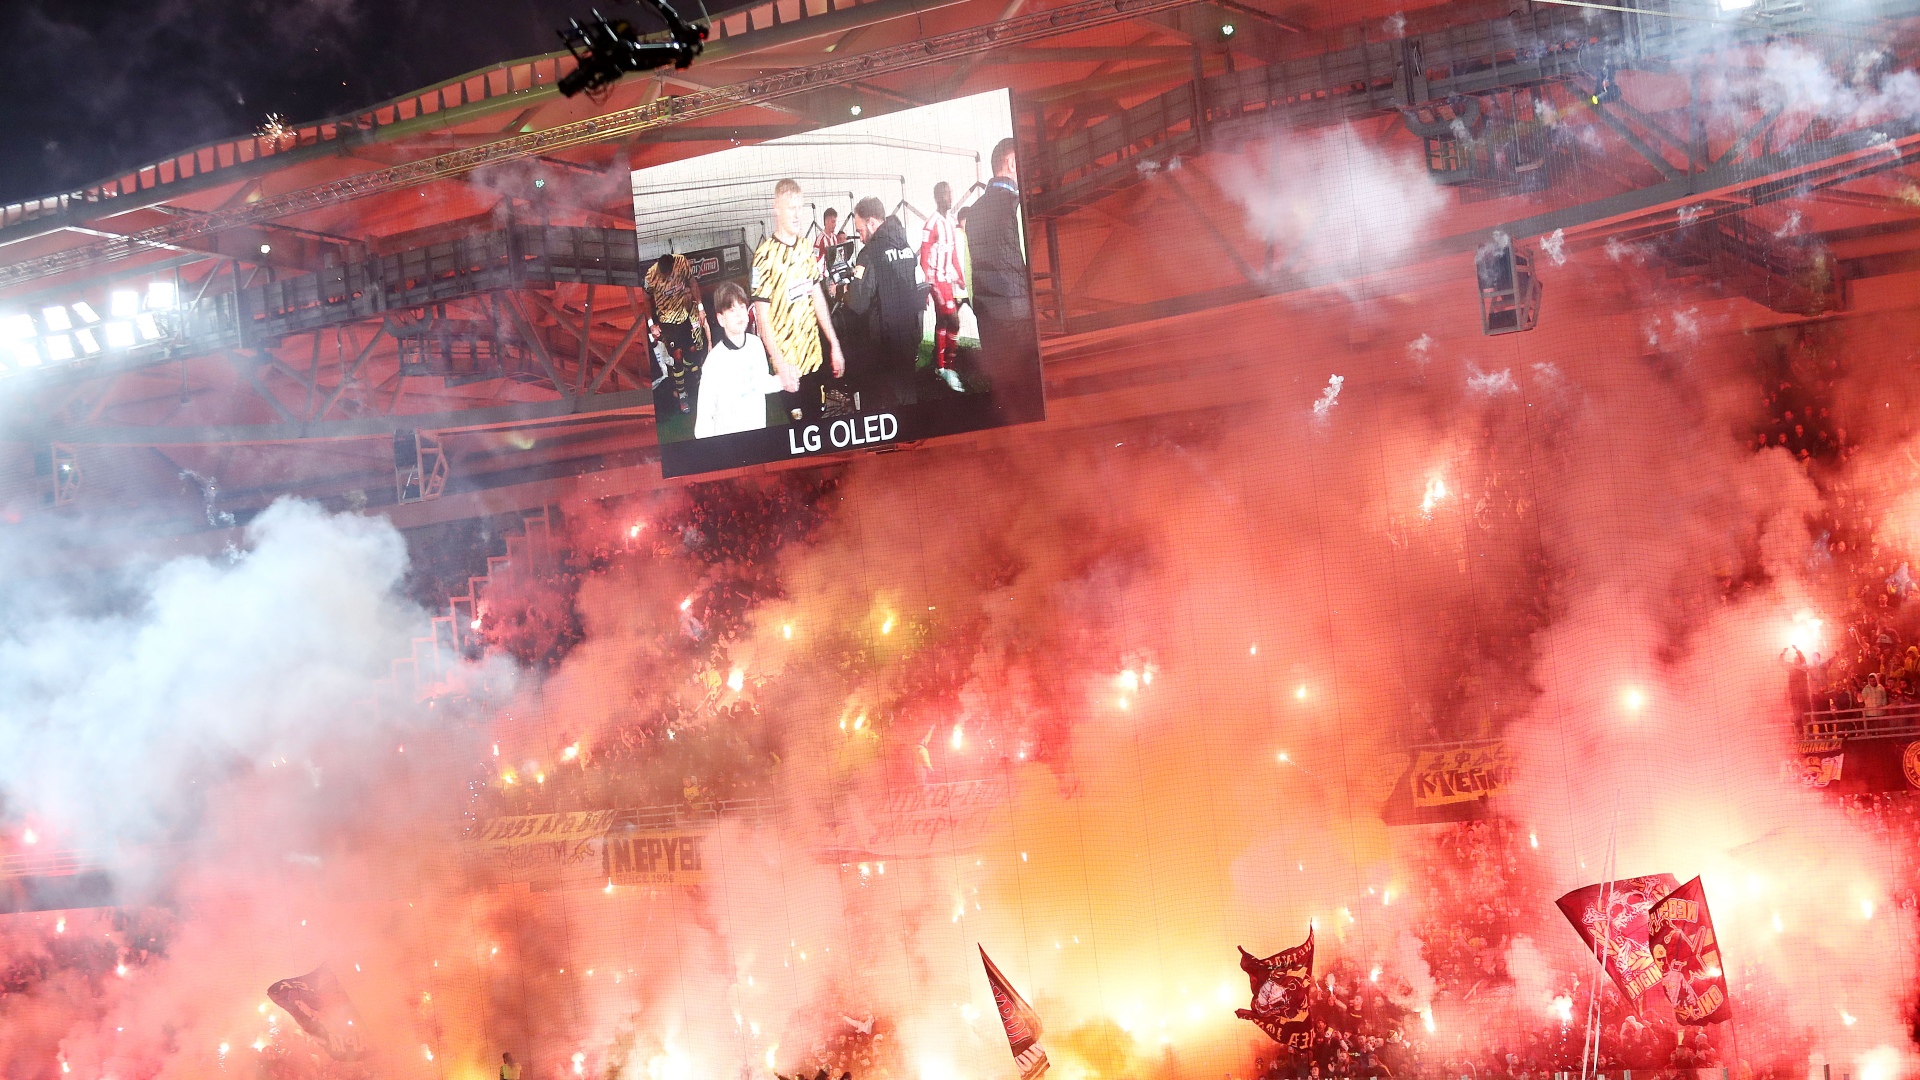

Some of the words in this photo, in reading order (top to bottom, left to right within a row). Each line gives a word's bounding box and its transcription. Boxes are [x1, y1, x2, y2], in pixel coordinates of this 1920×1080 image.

[885, 247, 897, 262] TV
[789, 424, 821, 455] LG
[829, 412, 898, 449] OLED
